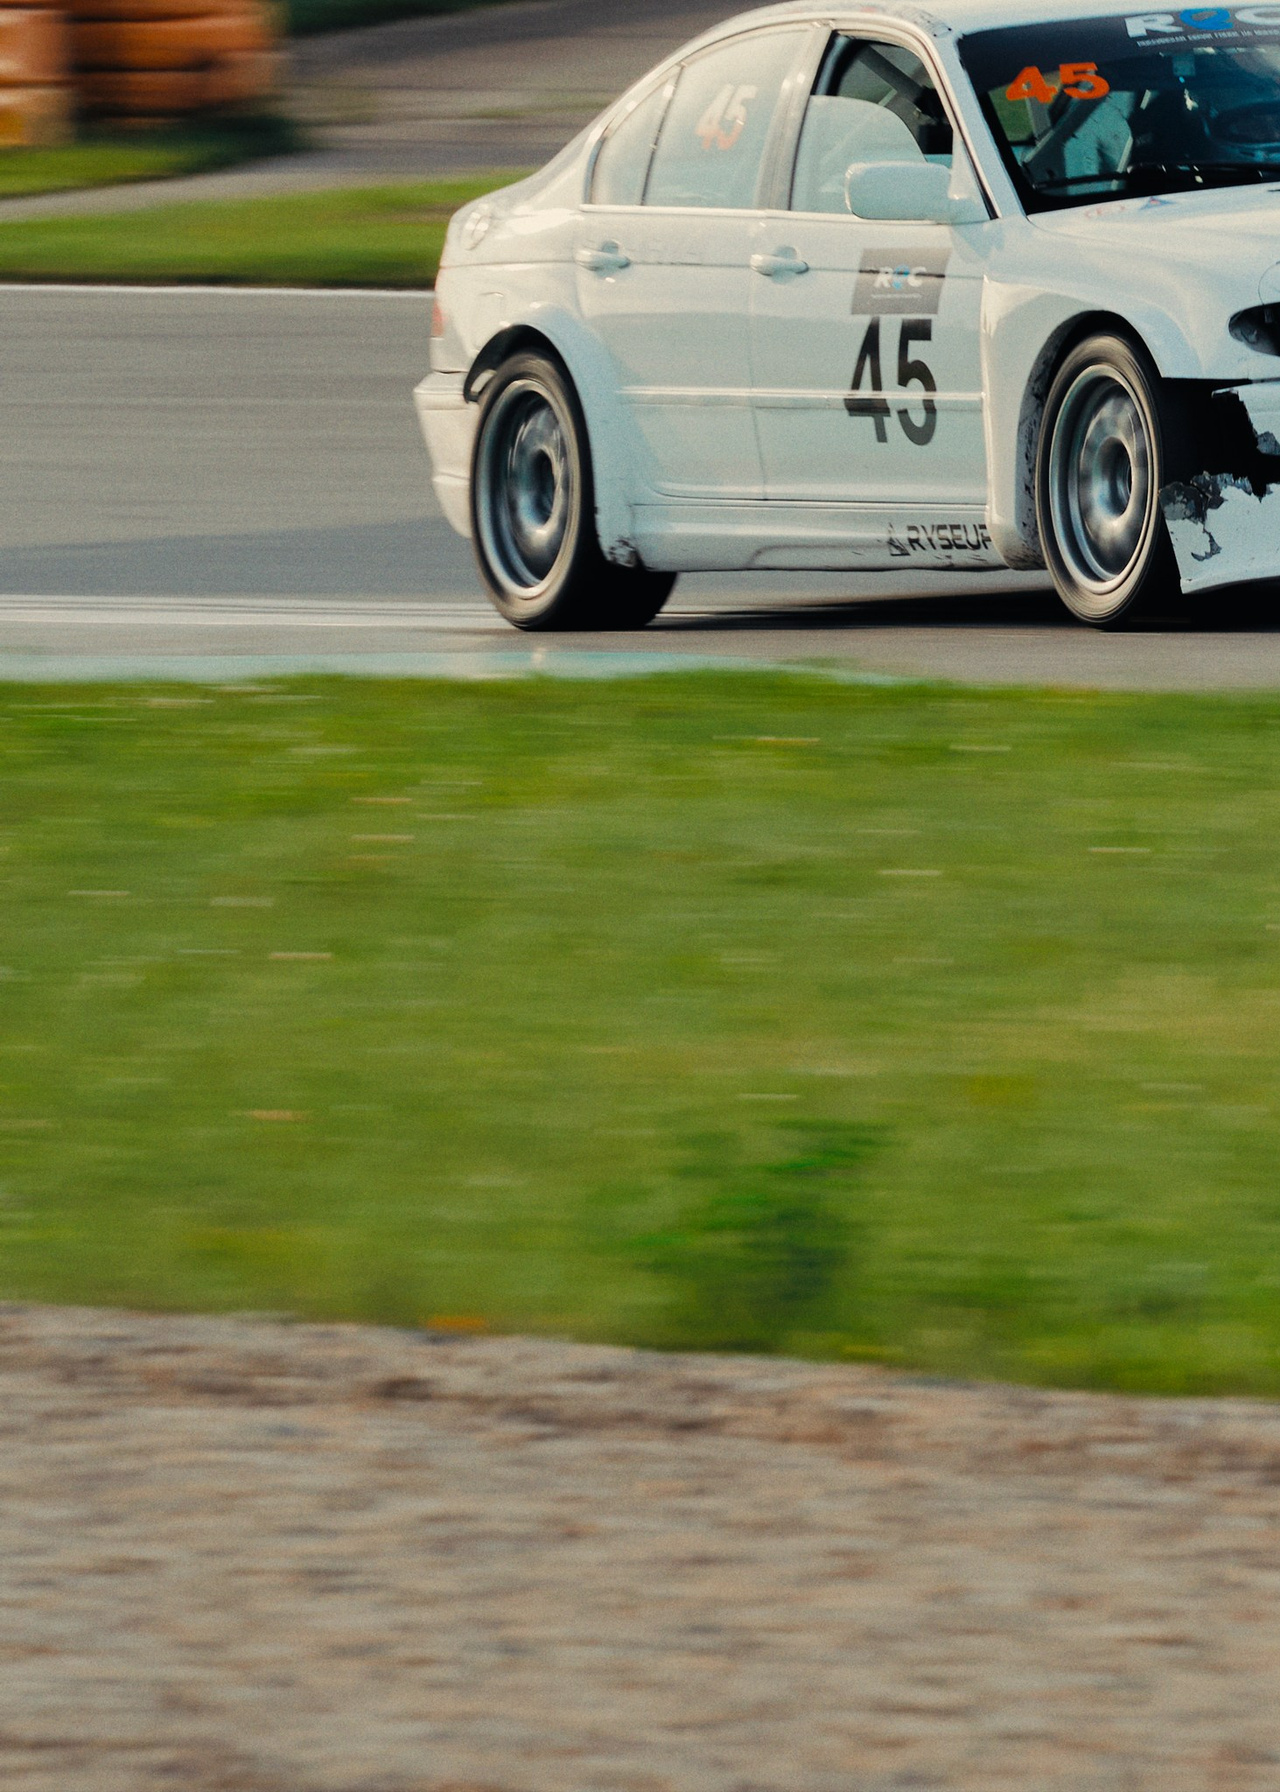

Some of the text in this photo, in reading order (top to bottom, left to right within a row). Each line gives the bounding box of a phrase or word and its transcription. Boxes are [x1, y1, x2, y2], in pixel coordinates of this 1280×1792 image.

[1005, 62, 1110, 104] 45
[694, 84, 757, 151] 45
[843, 316, 938, 446] 45
